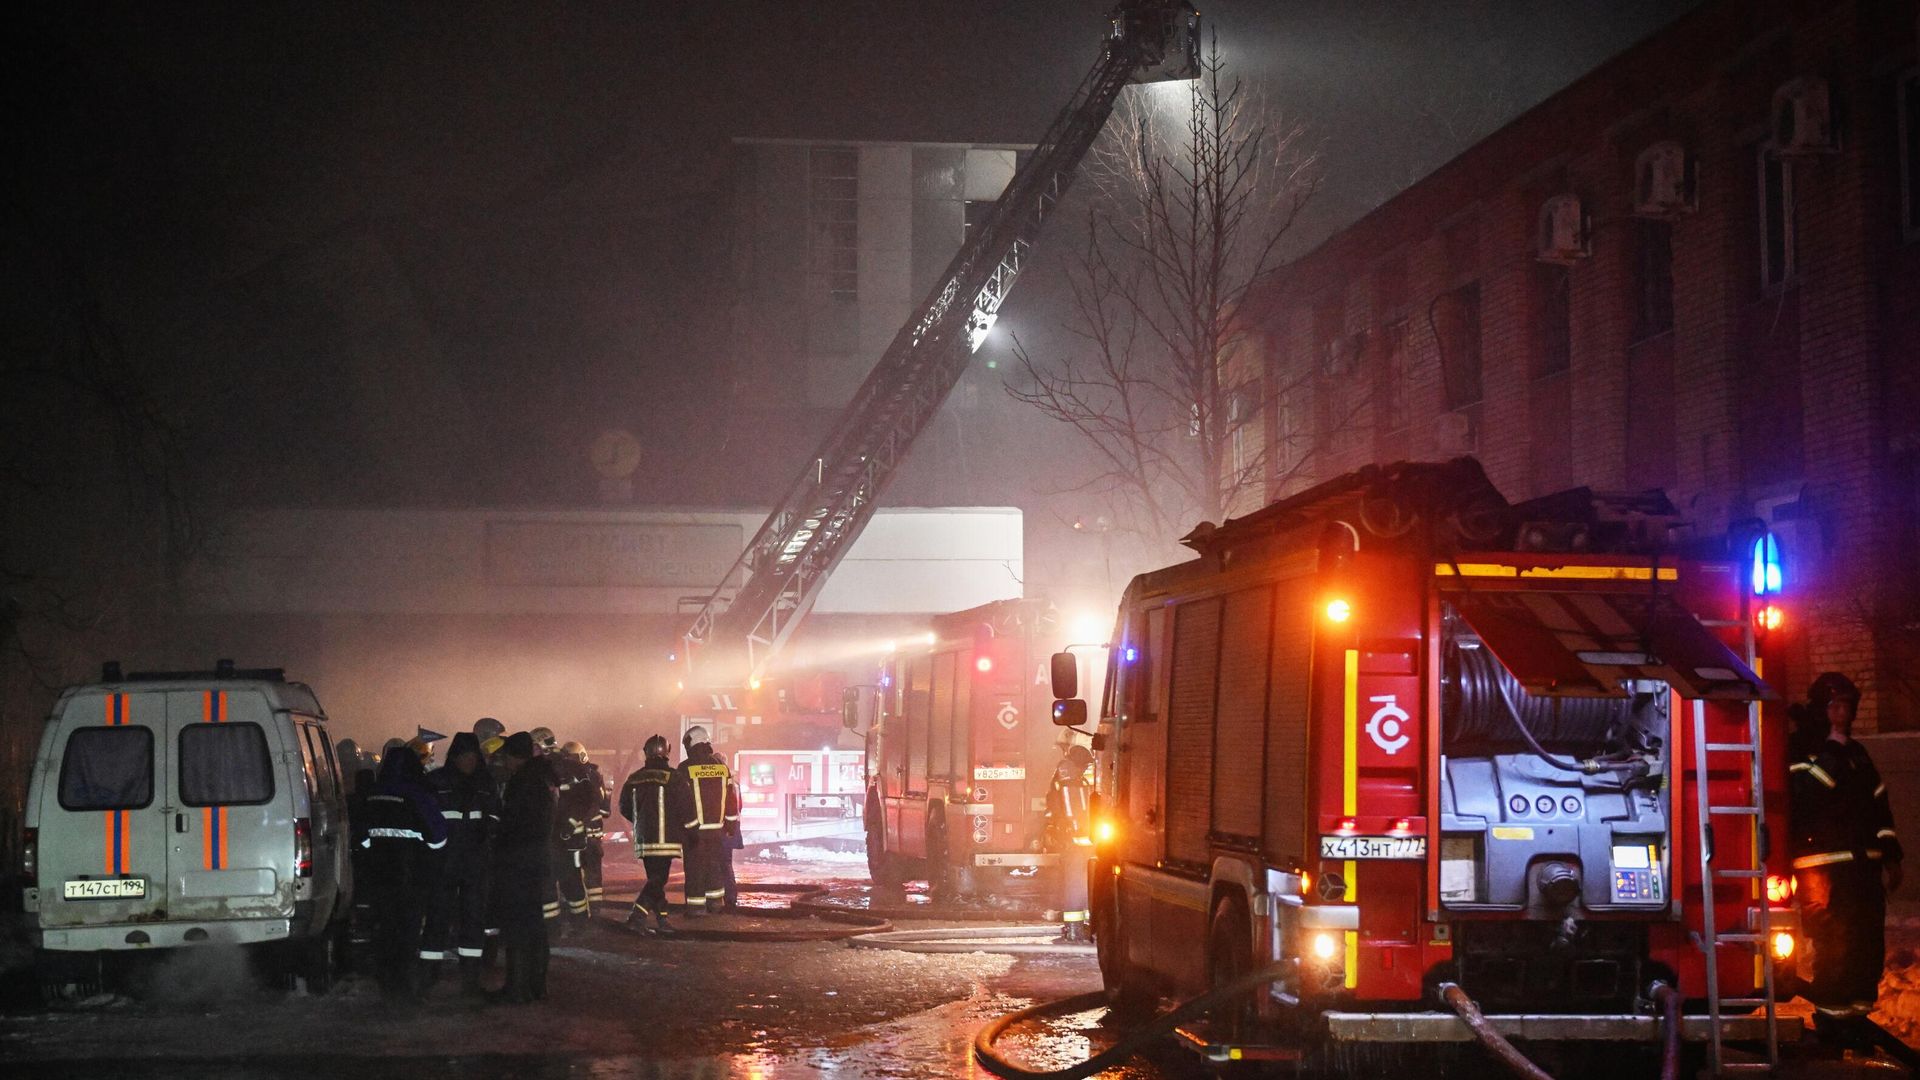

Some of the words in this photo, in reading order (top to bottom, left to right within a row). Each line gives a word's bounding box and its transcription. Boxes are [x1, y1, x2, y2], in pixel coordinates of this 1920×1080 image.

[1325, 839, 1391, 856] Х413НТ
[1395, 838, 1421, 852] 777
[70, 882, 119, 896] Т147СТ
[123, 881, 141, 890] 199
